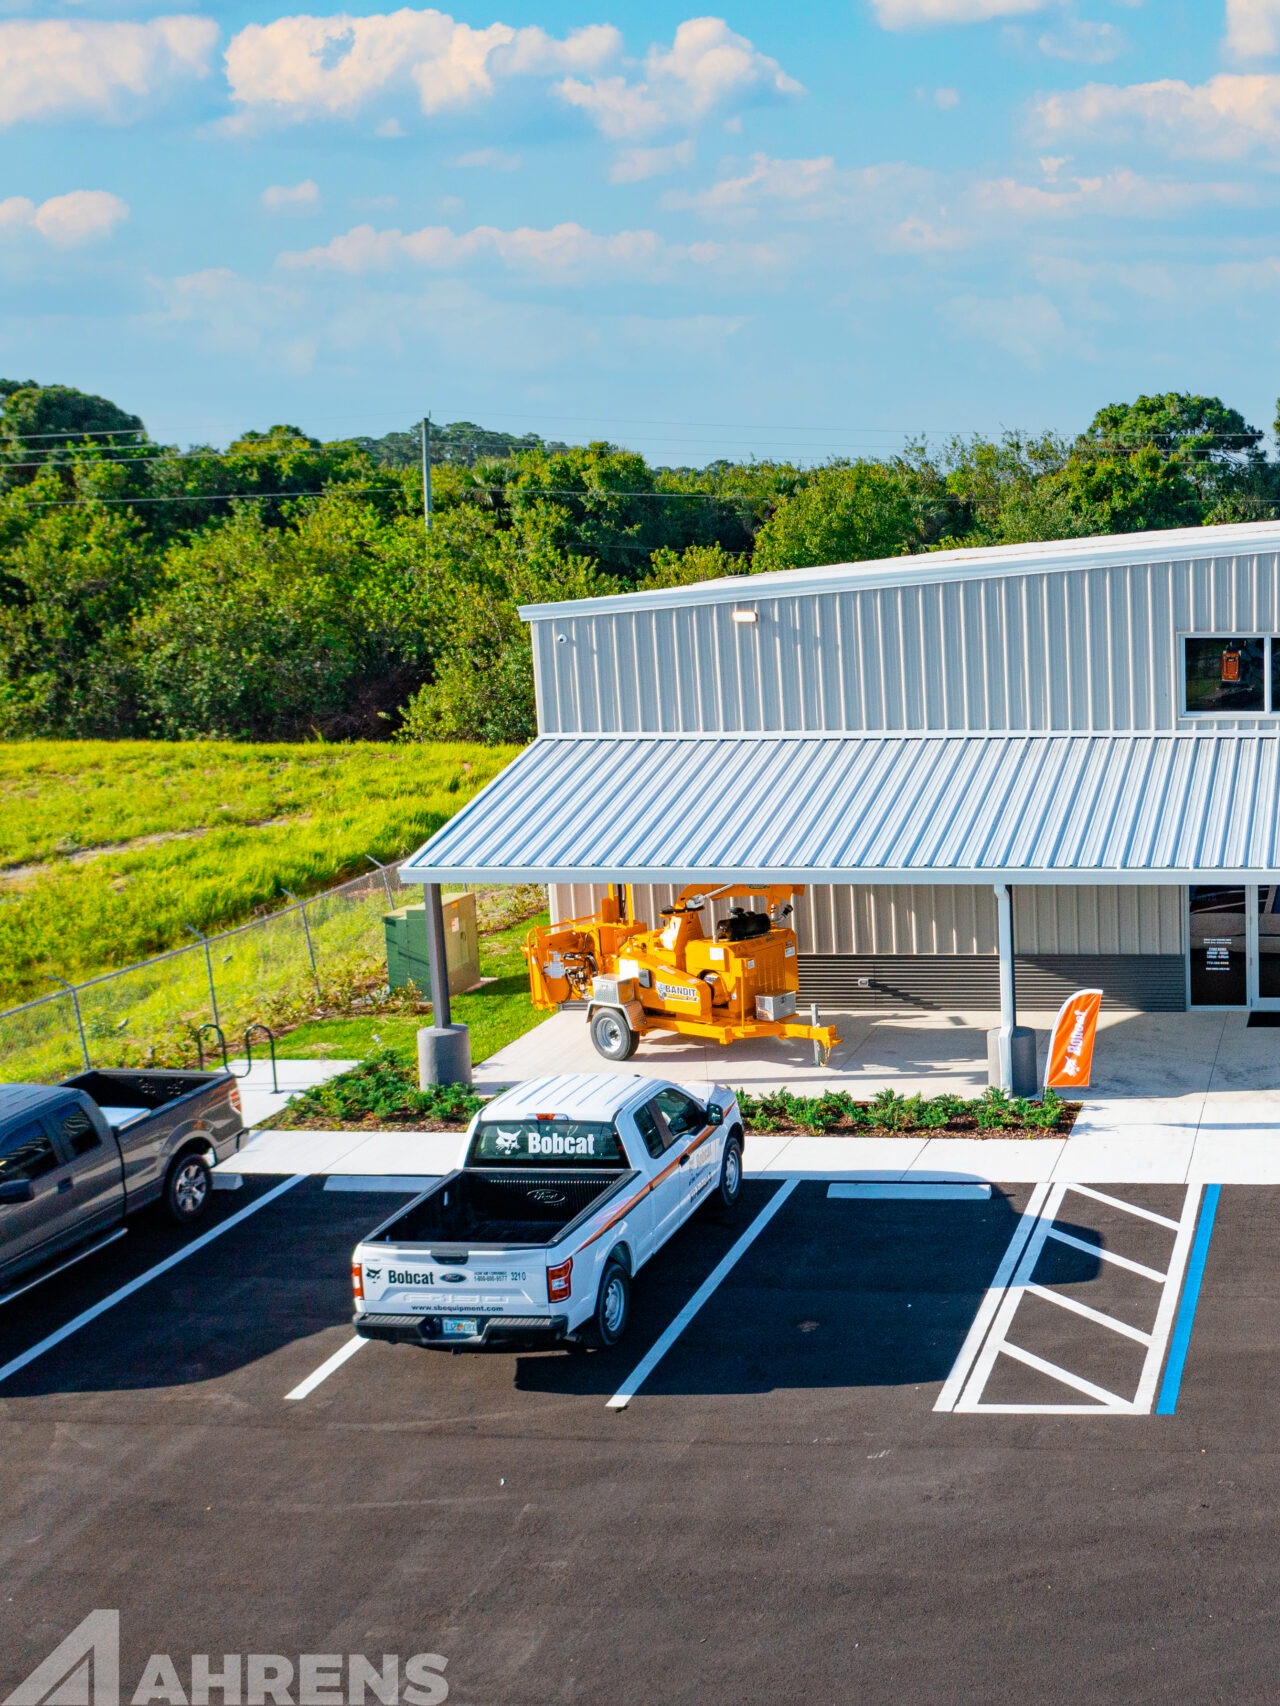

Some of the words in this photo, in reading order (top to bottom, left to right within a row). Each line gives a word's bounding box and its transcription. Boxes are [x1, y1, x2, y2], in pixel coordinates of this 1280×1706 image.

[665, 985, 696, 997] BANDIT
[528, 1133, 594, 1155] Bobcat
[388, 1270, 434, 1285] Bobcat
